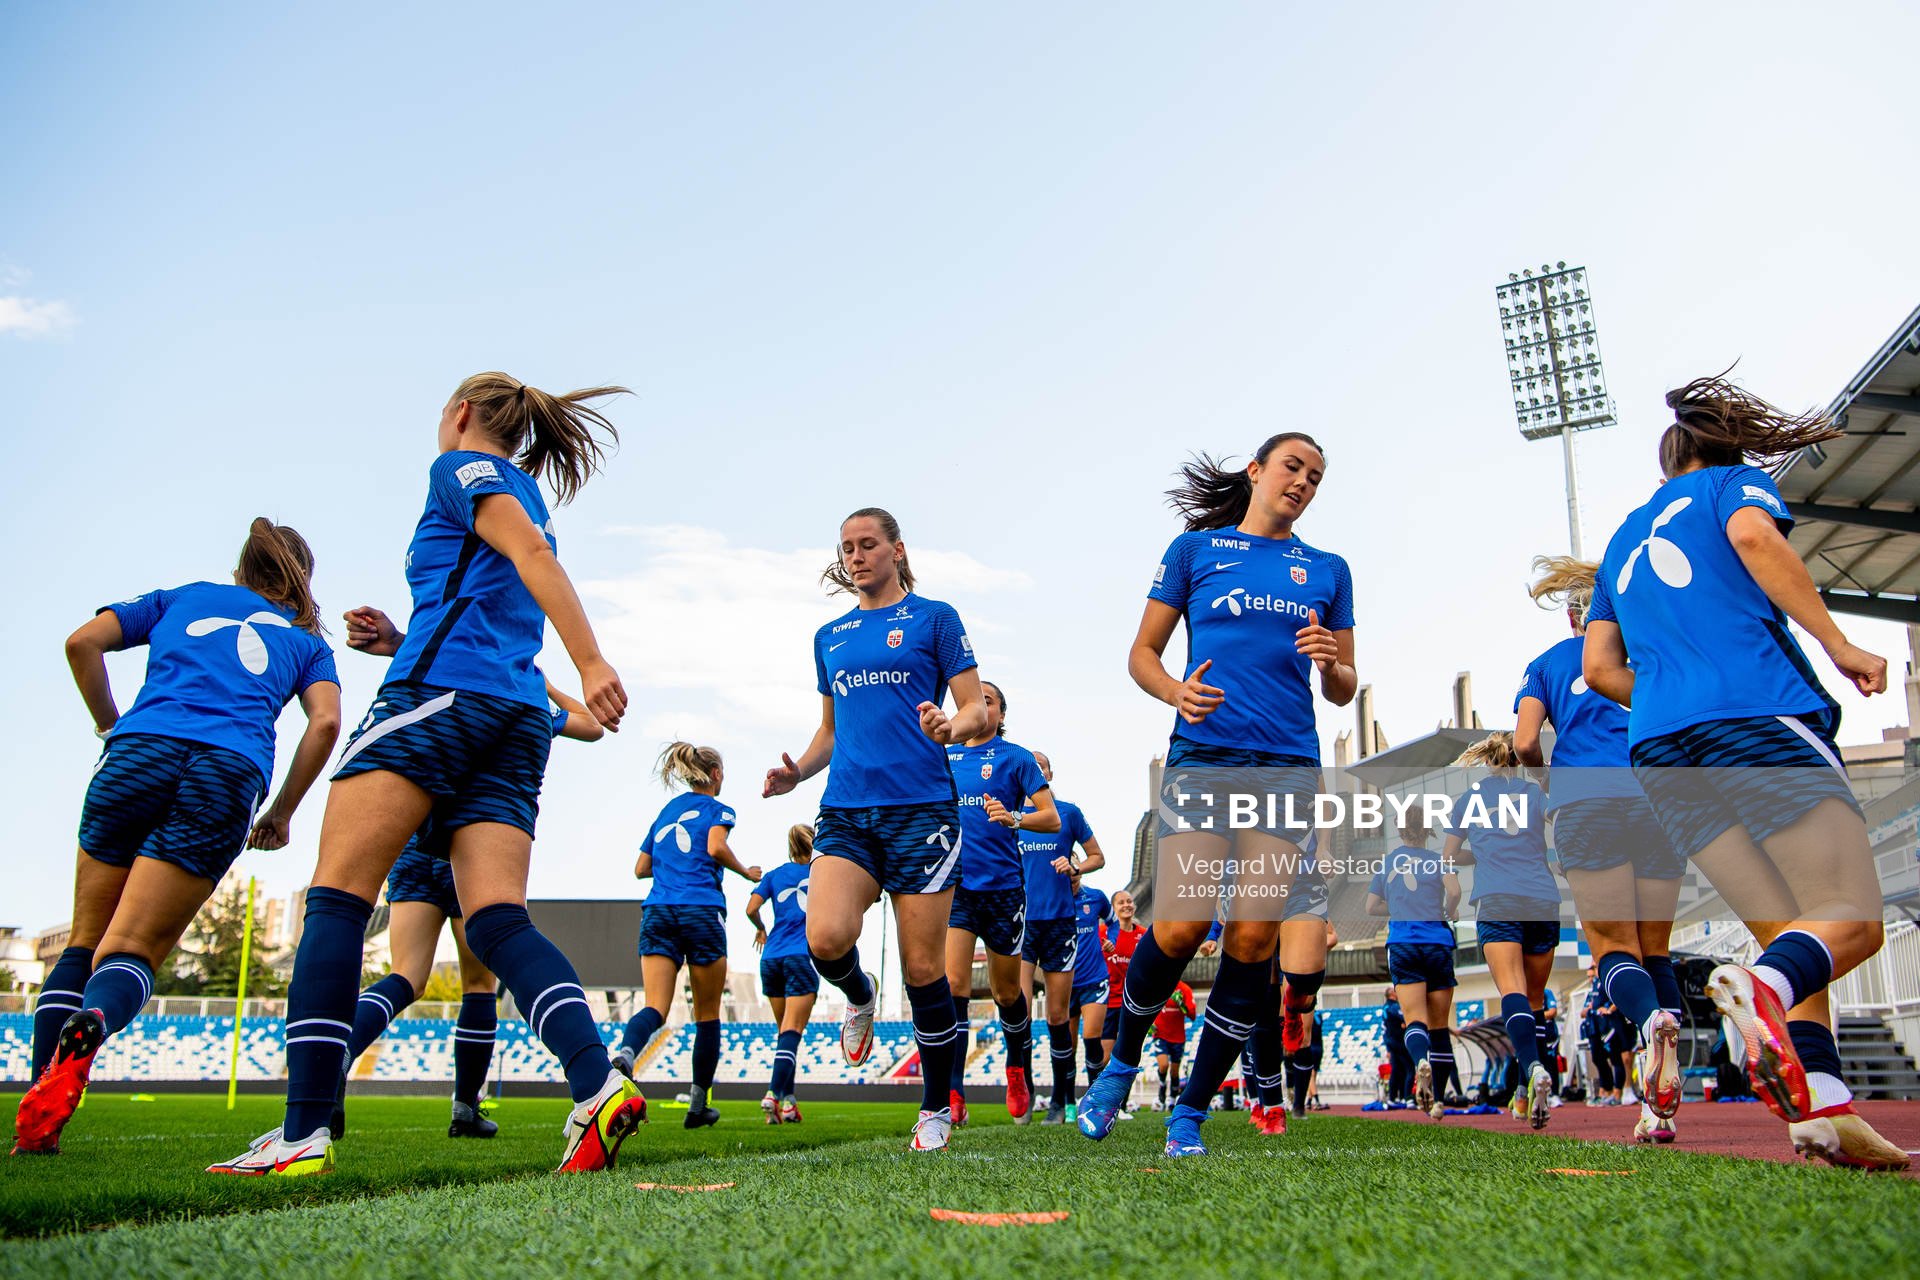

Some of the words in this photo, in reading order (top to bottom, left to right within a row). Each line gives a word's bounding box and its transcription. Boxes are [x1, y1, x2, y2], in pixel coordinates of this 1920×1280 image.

[460, 462, 493, 481] DNB
[1211, 538, 1238, 550] KIWI
[1243, 593, 1309, 619] teleno
[845, 669, 911, 688] telenor
[957, 793, 997, 806] elen
[1023, 841, 1058, 852] telenor
